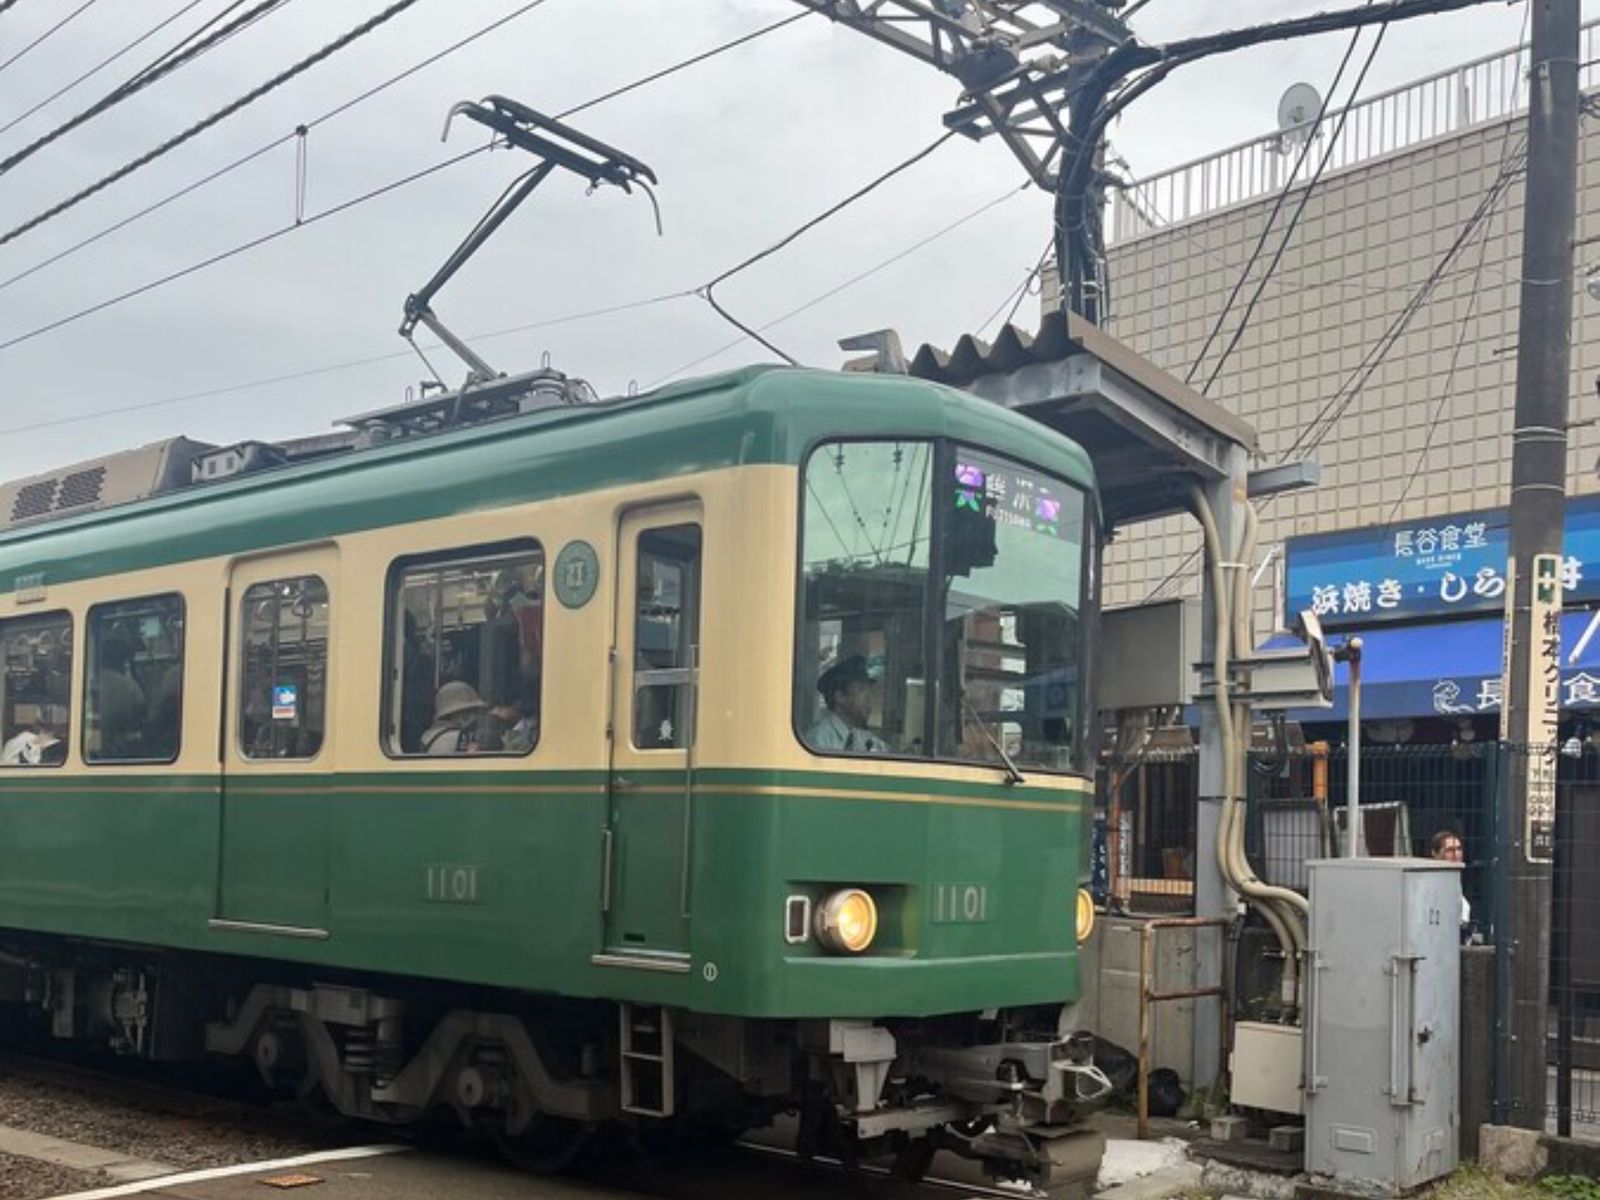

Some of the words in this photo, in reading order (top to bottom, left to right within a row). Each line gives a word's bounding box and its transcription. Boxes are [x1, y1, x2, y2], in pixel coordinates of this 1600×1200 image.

[1394, 522, 1488, 557] 長谷食堂
[428, 868, 477, 899] 1101
[938, 886, 987, 920] 1101
